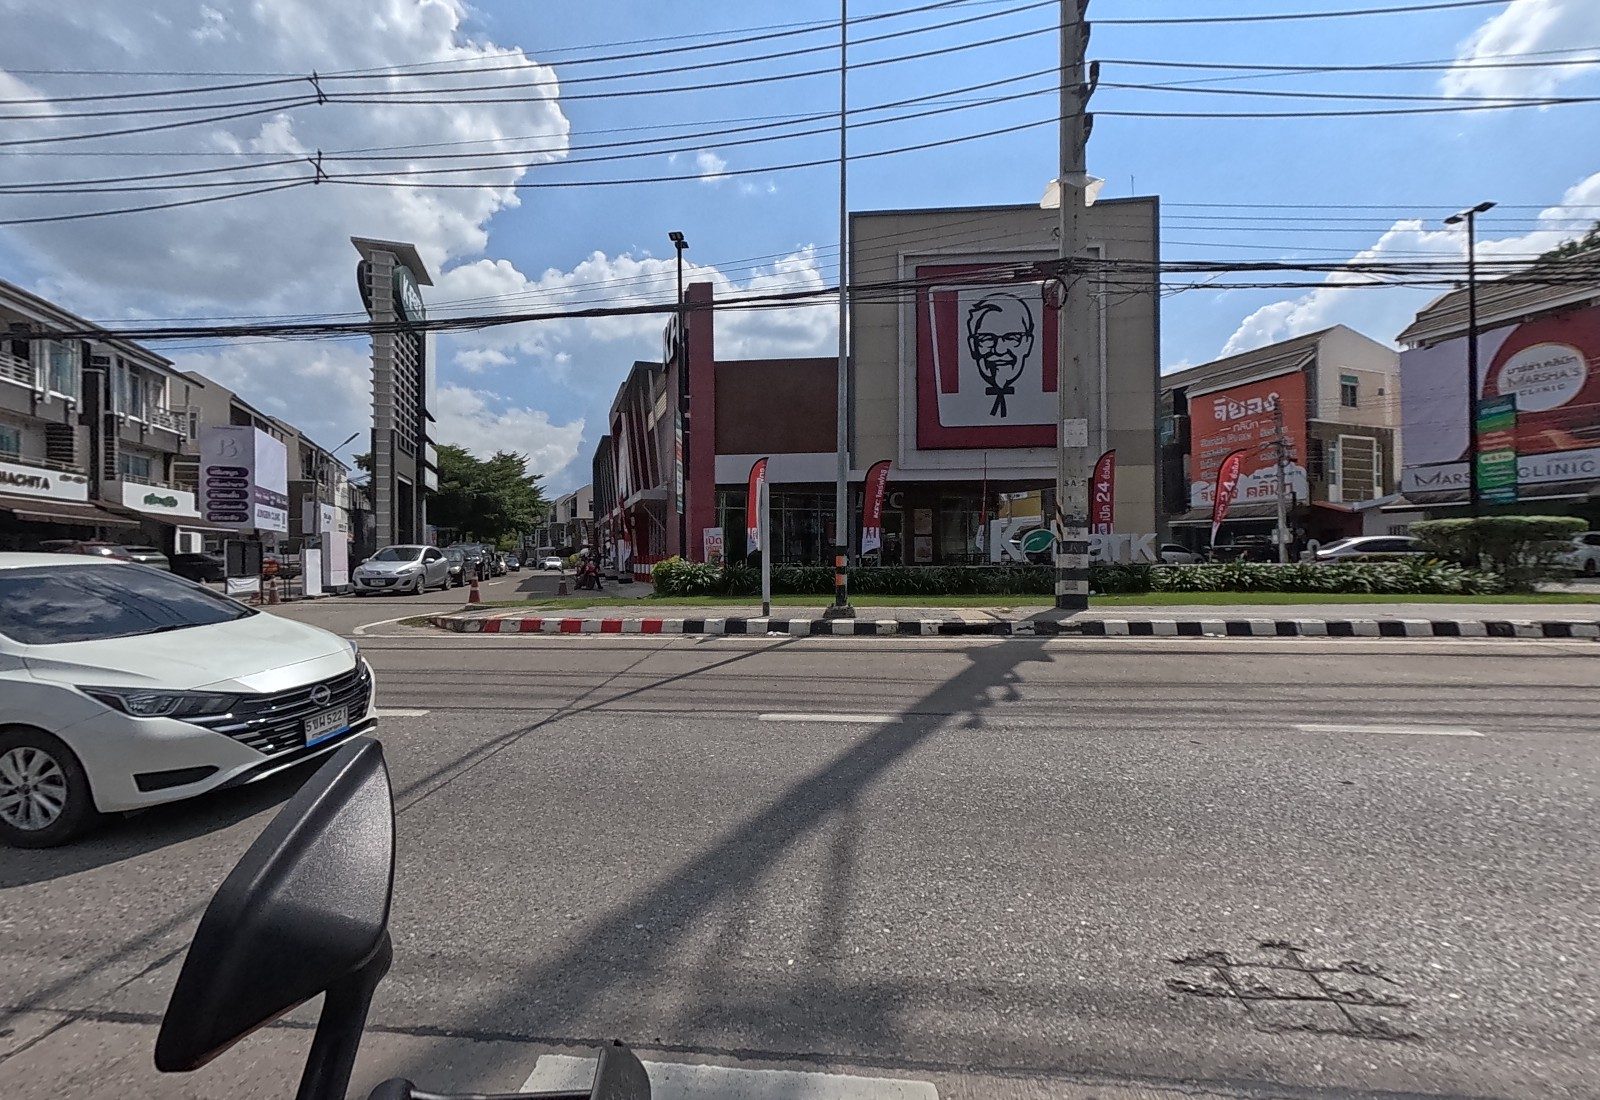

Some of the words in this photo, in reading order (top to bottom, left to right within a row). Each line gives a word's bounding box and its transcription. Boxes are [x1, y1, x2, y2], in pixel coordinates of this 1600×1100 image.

[1519, 383, 1566, 396] CLINIC
[1517, 460, 1596, 479] CLINIC
[0, 470, 50, 491] ACHITA
[1097, 482, 1111, 503] 24
